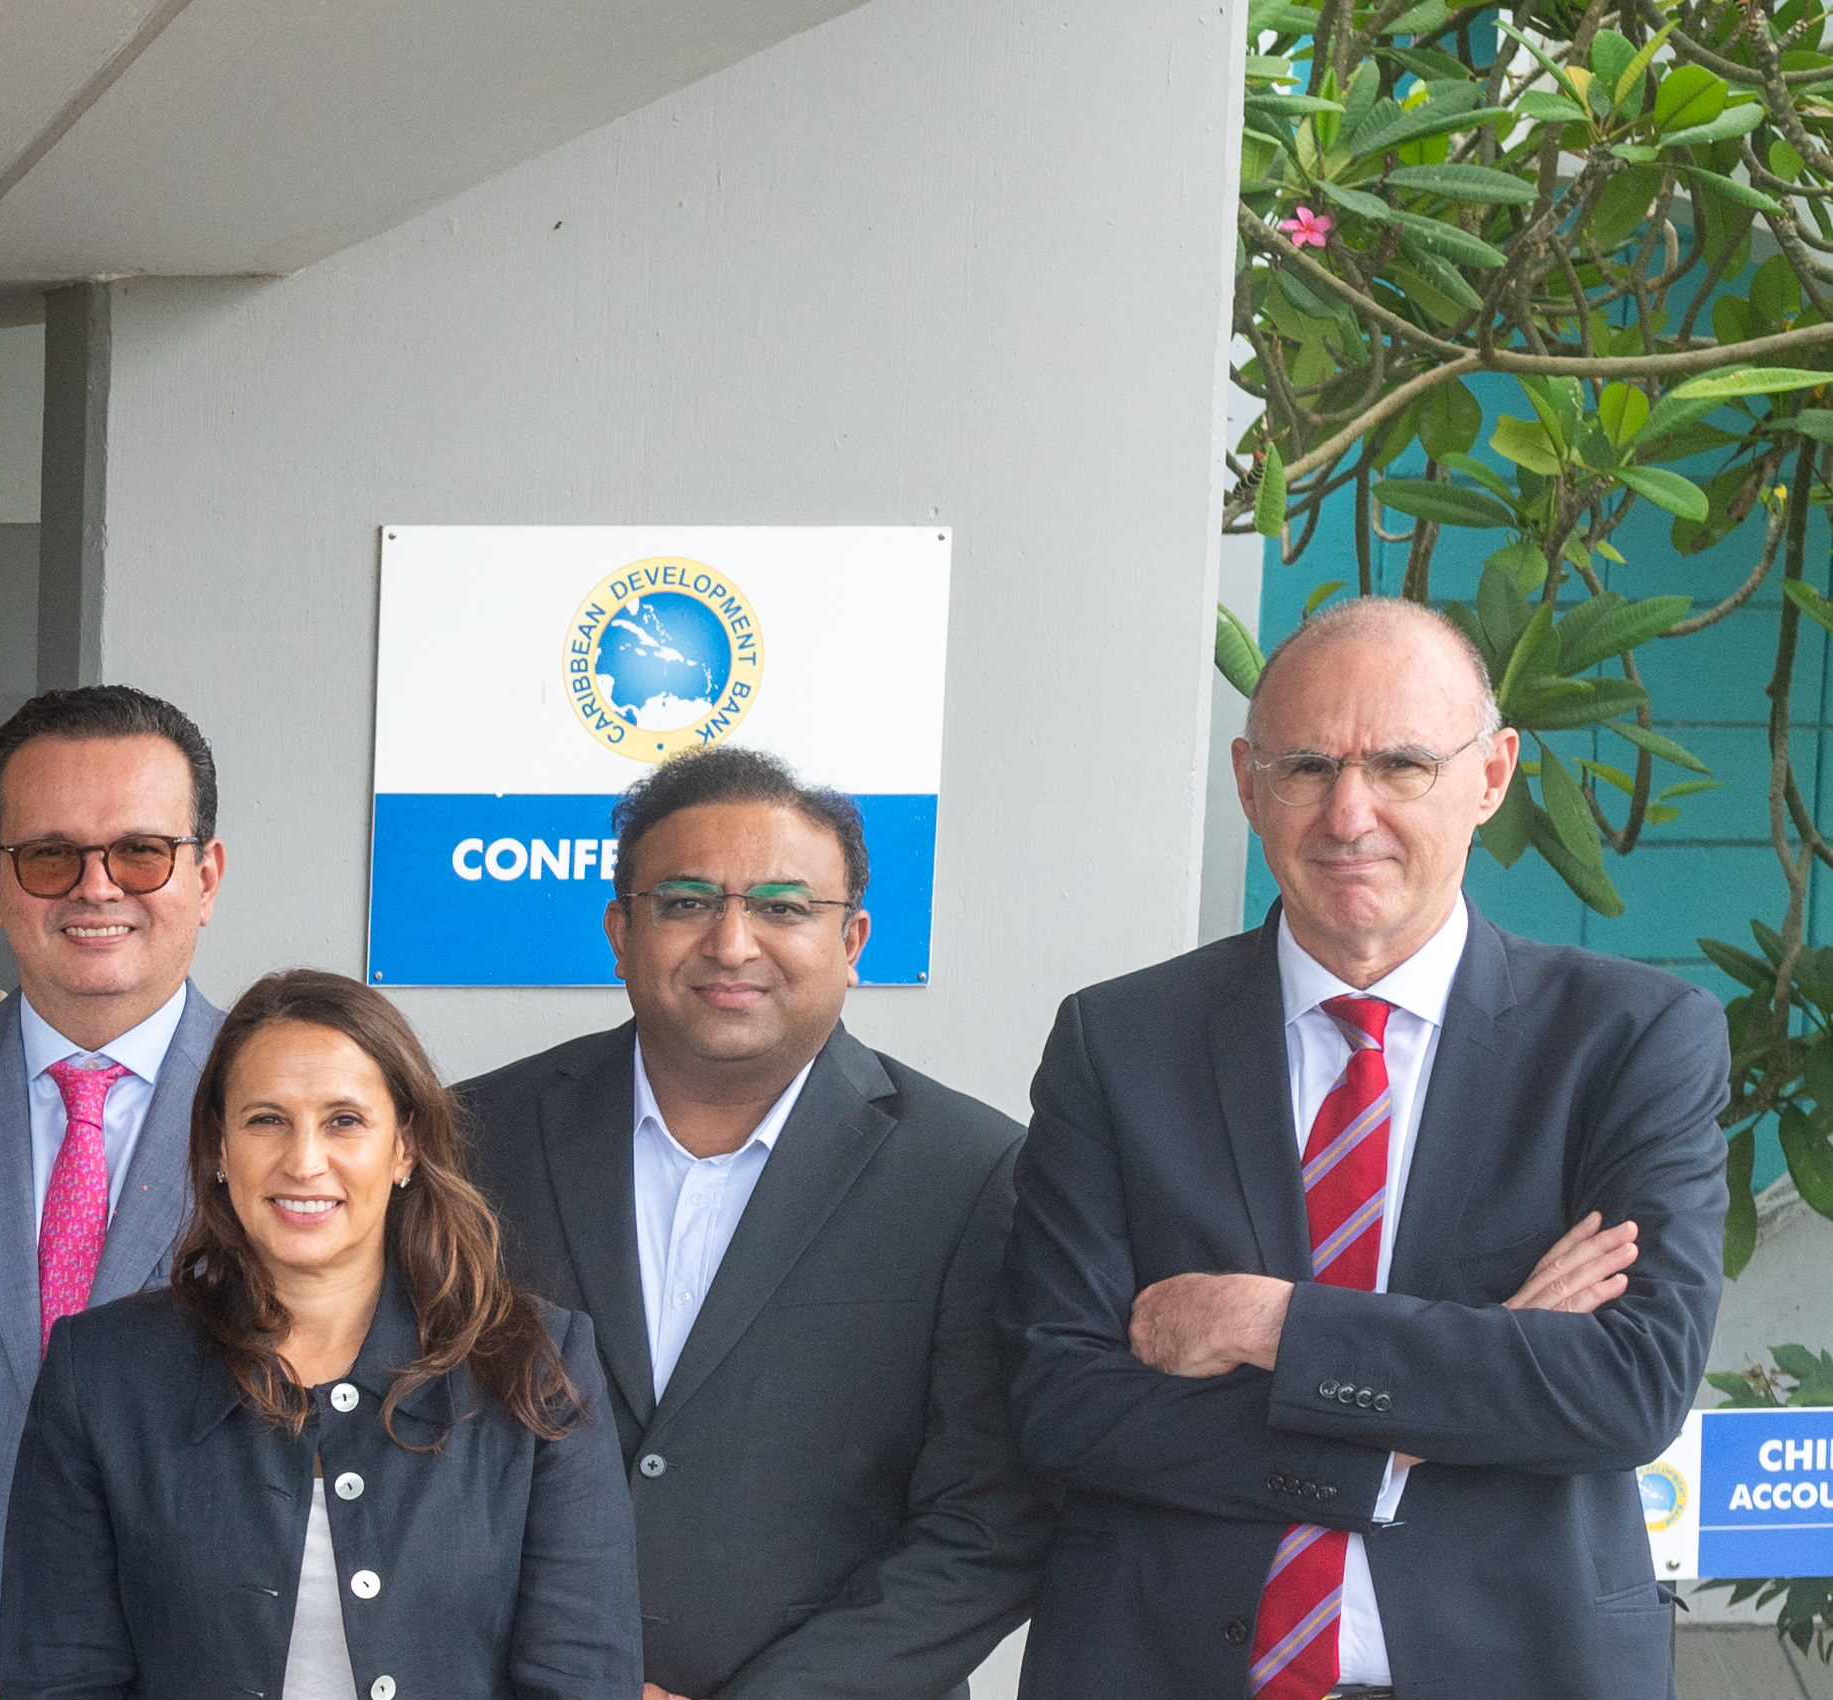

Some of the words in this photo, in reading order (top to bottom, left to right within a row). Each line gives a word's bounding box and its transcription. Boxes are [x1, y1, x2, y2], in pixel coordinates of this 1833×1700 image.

[570, 602, 626, 744] CARIBBEAN
[609, 565, 757, 667] DEVELOPMENT
[694, 680, 752, 745] BANK
[452, 837, 619, 881] CONFE
[1758, 1438, 1833, 1472] CHI
[1729, 1481, 1833, 1511] ACCOU
